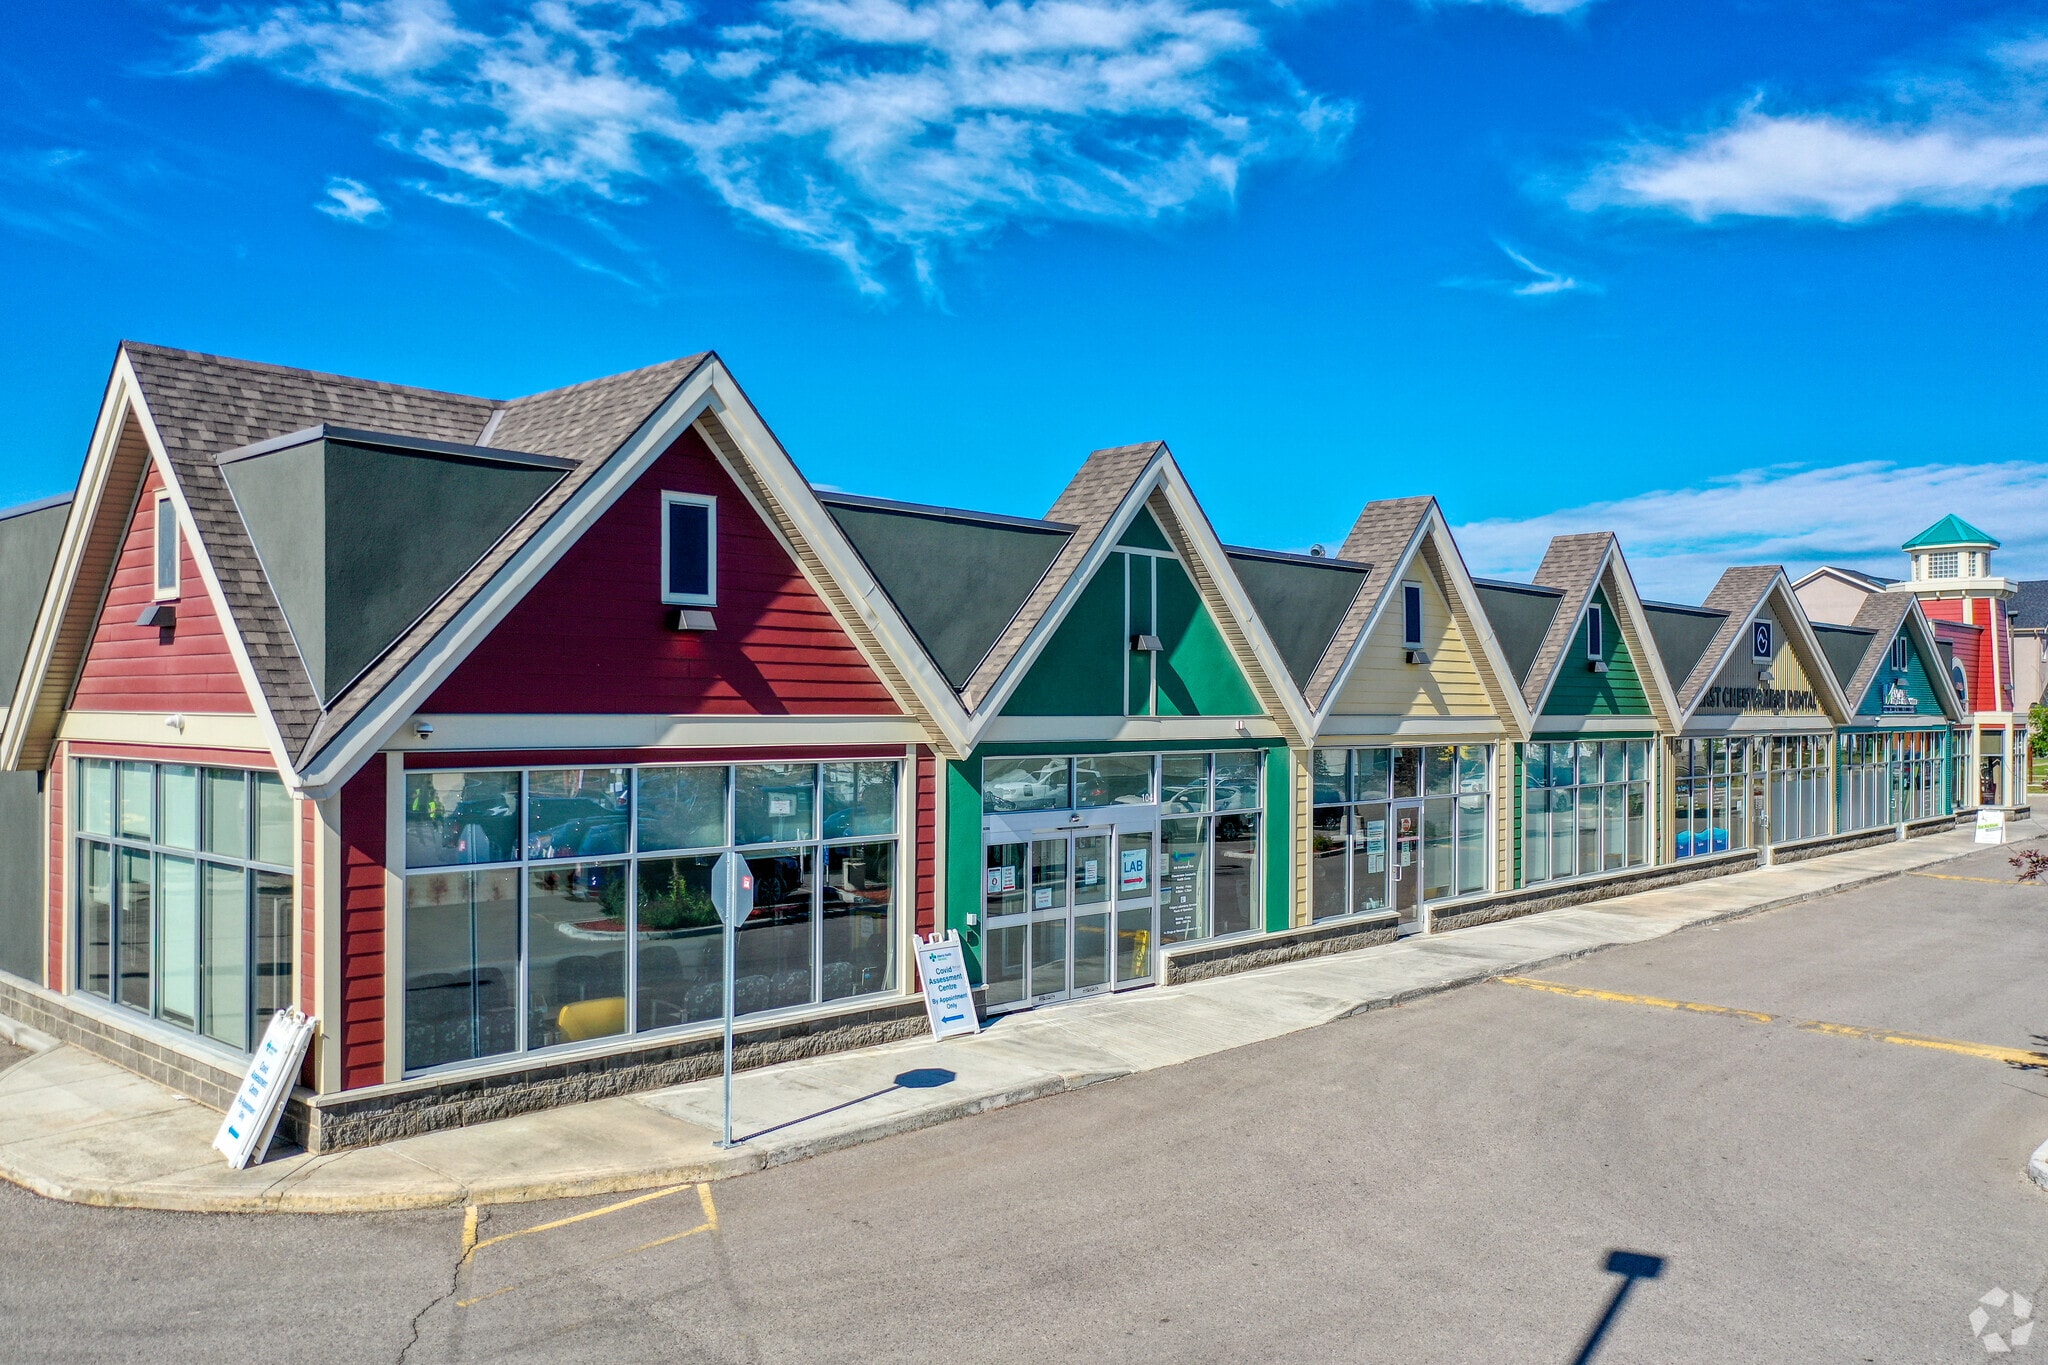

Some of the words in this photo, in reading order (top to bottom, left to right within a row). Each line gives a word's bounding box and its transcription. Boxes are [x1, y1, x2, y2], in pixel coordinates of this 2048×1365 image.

[1124, 860, 1143, 873] LAB
[936, 966, 952, 975] Covid
[929, 973, 963, 985] Assessment
[938, 983, 957, 992] Centre
[939, 993, 967, 1003] Appointment
